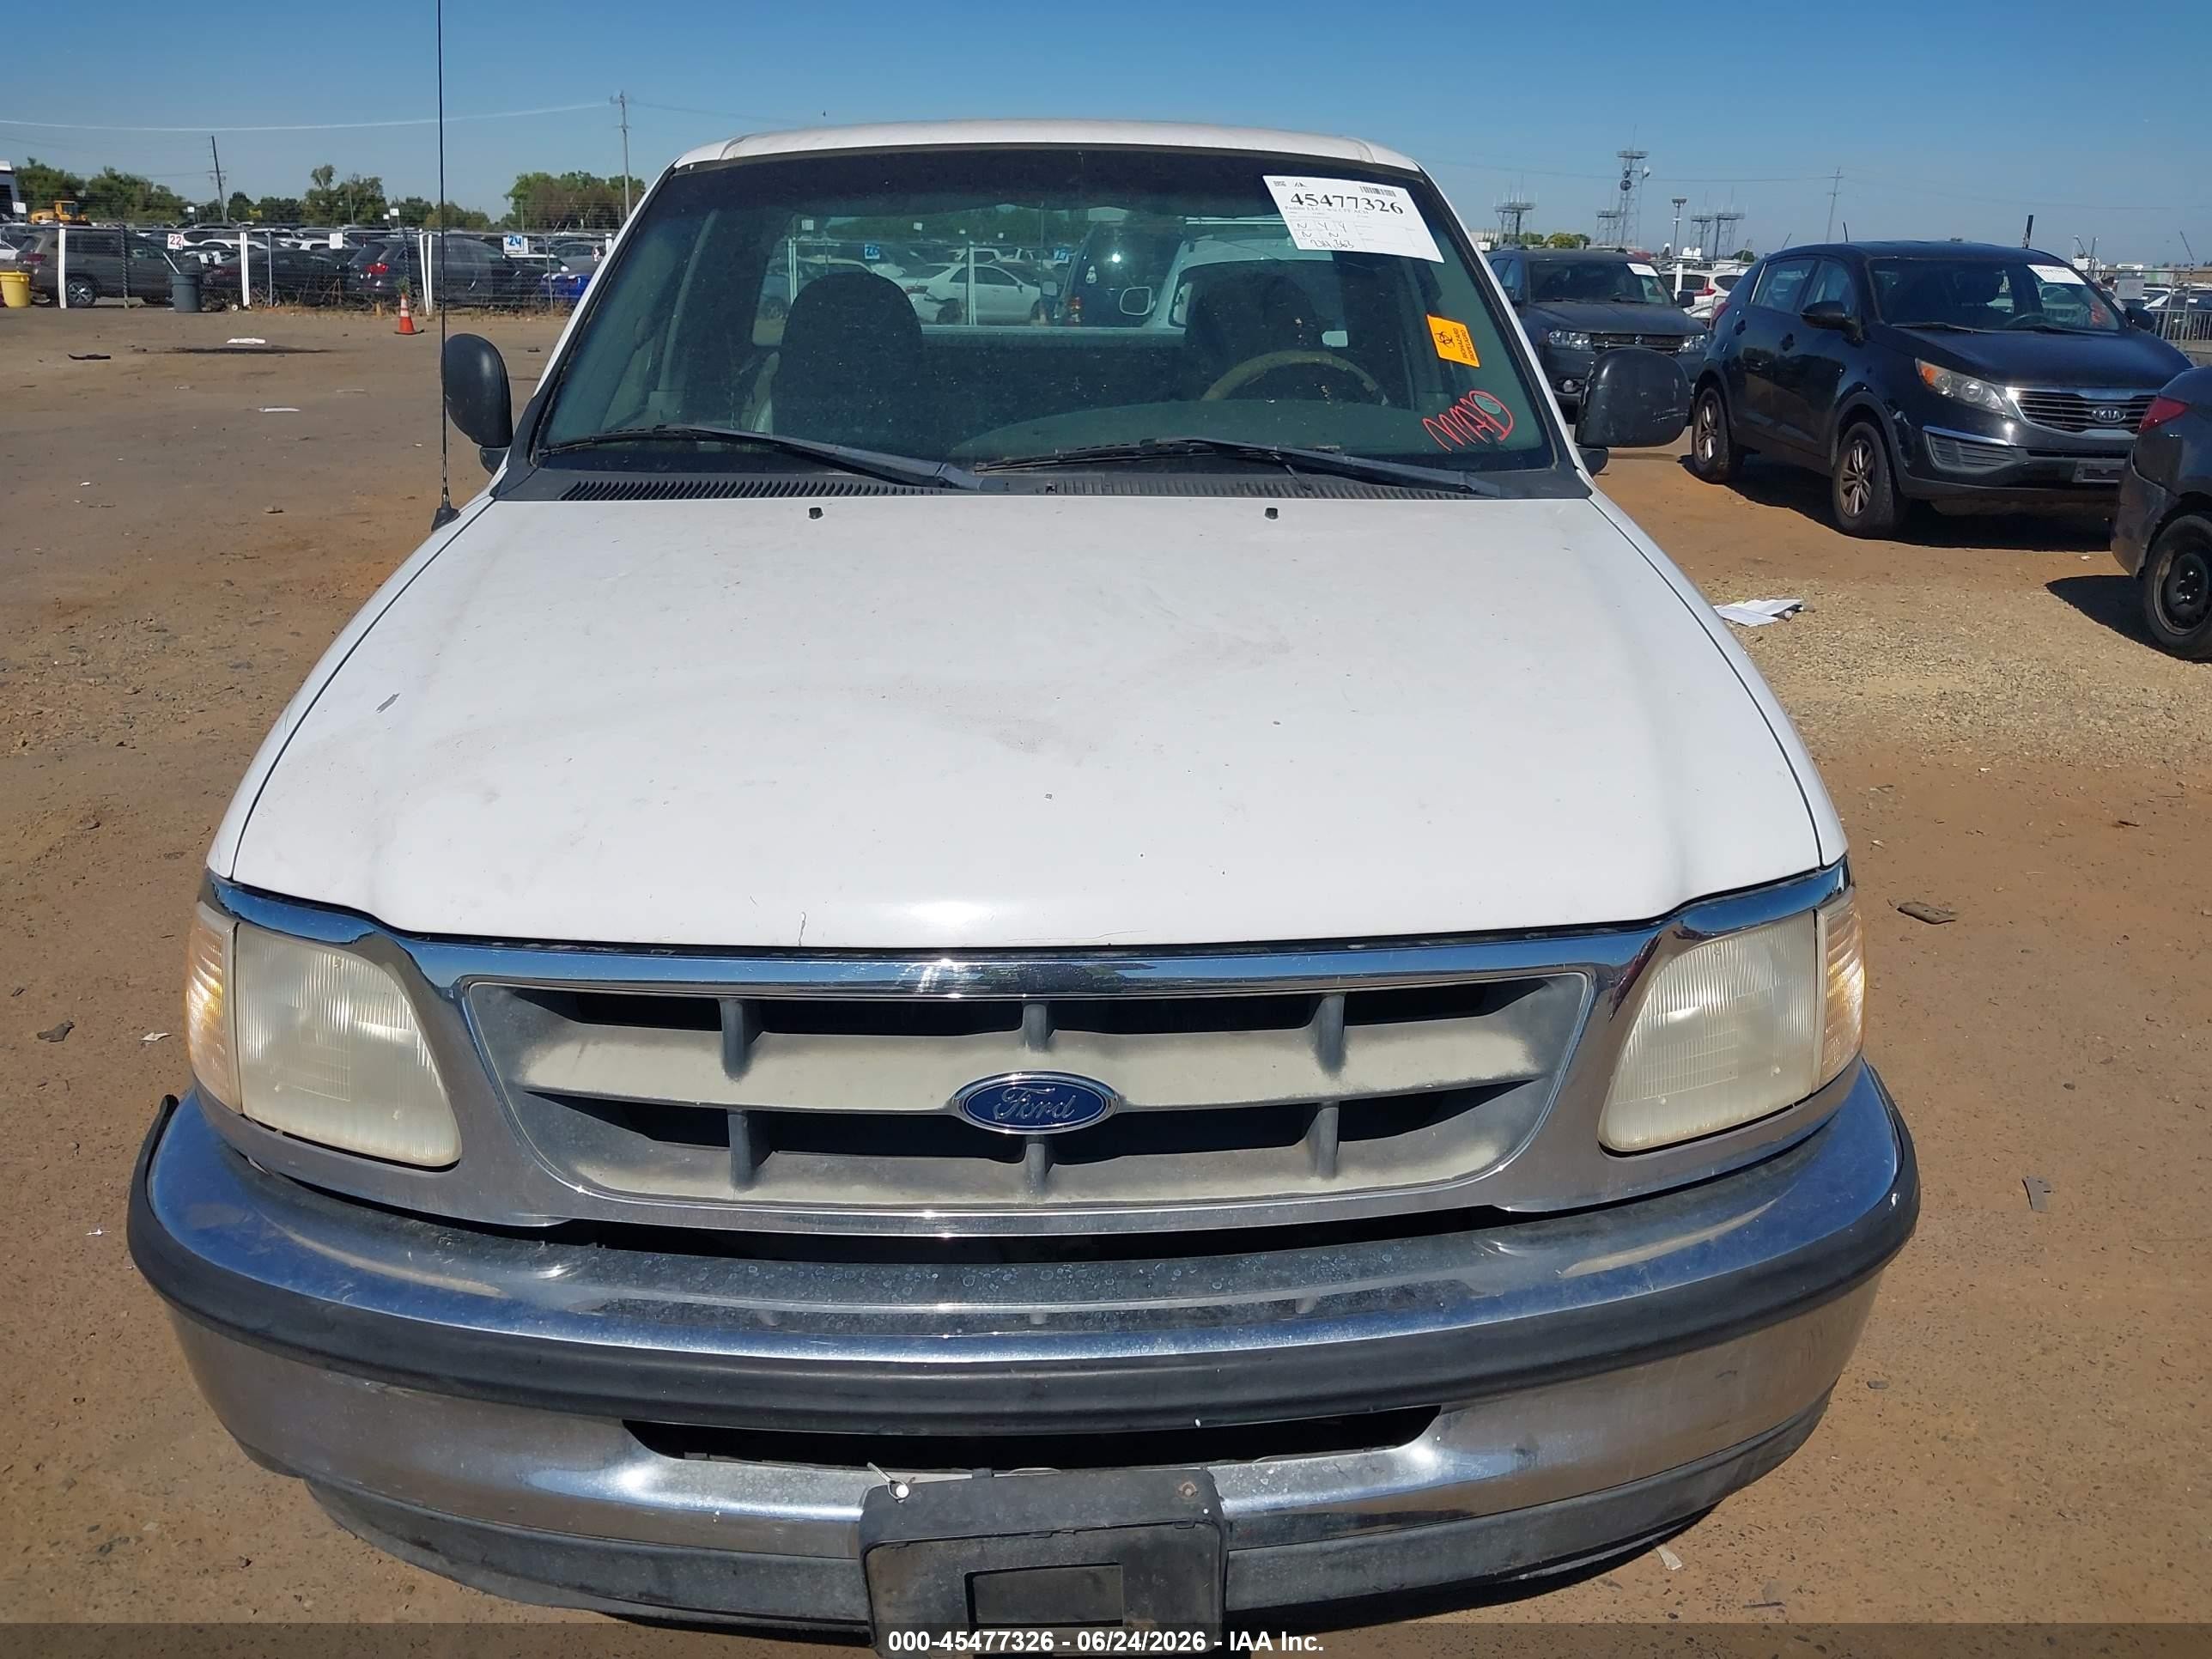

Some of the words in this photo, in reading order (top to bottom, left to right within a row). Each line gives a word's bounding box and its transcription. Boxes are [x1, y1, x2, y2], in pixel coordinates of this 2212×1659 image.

[1291, 192, 1404, 215] 45477326
[169, 234, 182, 246] 22
[507, 234, 522, 247] 24
[2098, 410, 2121, 419] KIA
[993, 1085, 1077, 1121] Ford
